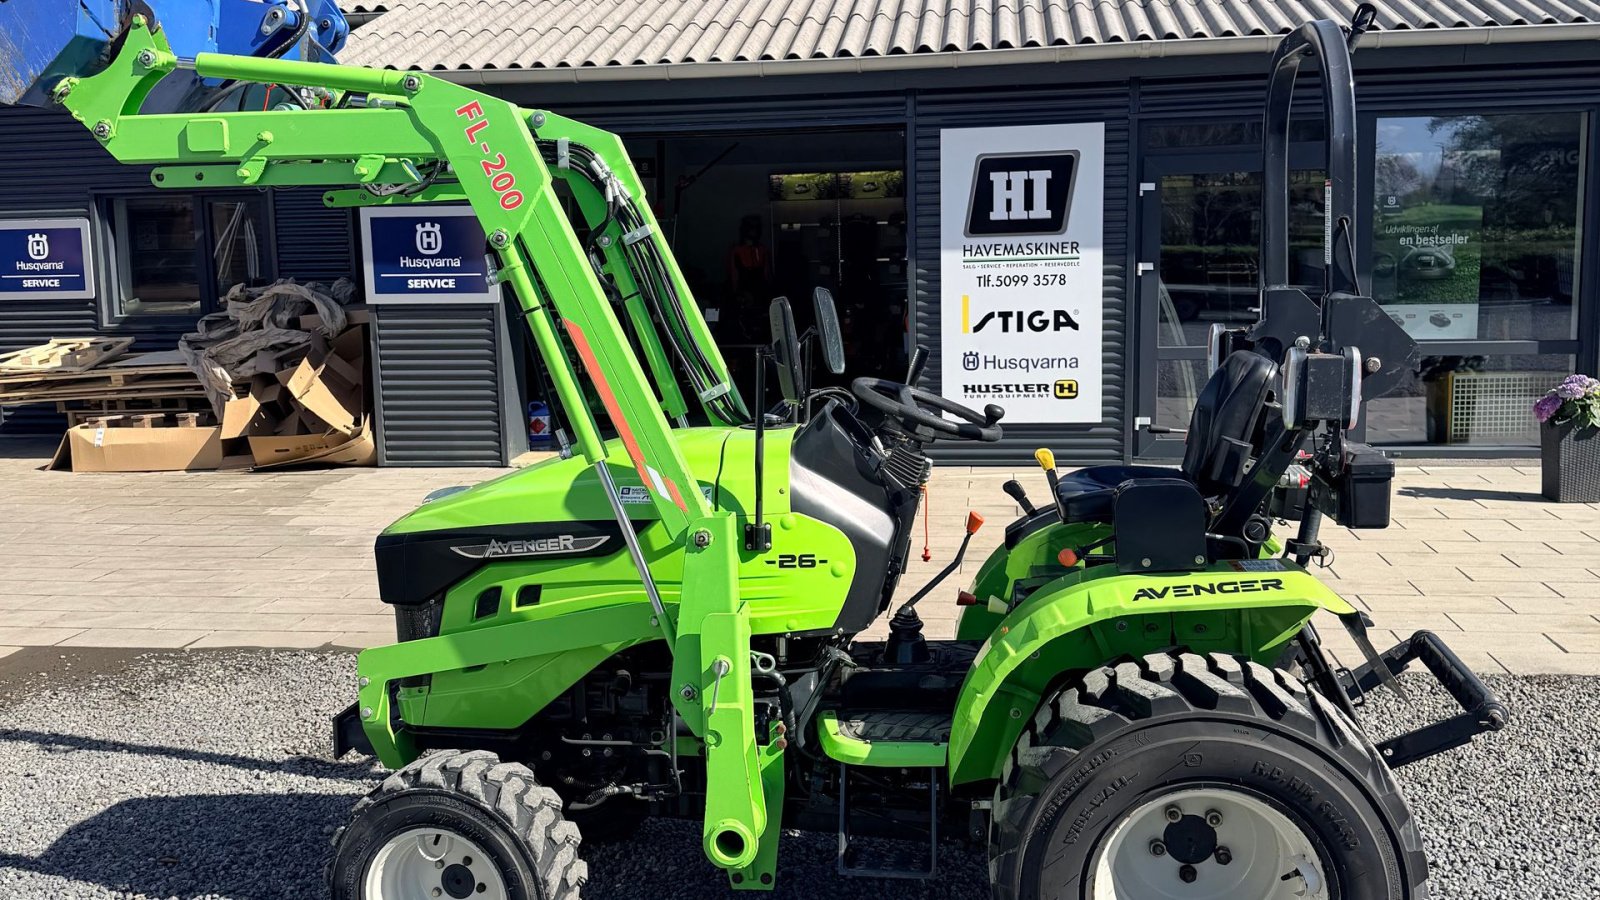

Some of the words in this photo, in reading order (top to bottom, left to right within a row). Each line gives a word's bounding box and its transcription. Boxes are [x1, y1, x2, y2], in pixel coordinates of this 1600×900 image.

[455, 99, 524, 210] FL-200
[989, 169, 1052, 221] HI
[1385, 224, 1430, 235] Udviklingen
[1399, 236, 1413, 245] en
[1415, 233, 1469, 245] bestseller
[962, 241, 1080, 257] HAVEMASKINER
[16, 261, 64, 271] Husqvarna
[400, 256, 461, 269] Husqvarna
[22, 279, 60, 287] SERVICE
[407, 279, 456, 288] SERVICE
[976, 274, 1029, 287] Tlf.5099
[1033, 273, 1067, 286] 3578
[973, 310, 1079, 333] STIGA
[984, 355, 1079, 373] Husqvarna
[962, 384, 1050, 393] HUSTLER
[484, 534, 574, 558] AVENGER
[1132, 578, 1285, 601] AVENGER
